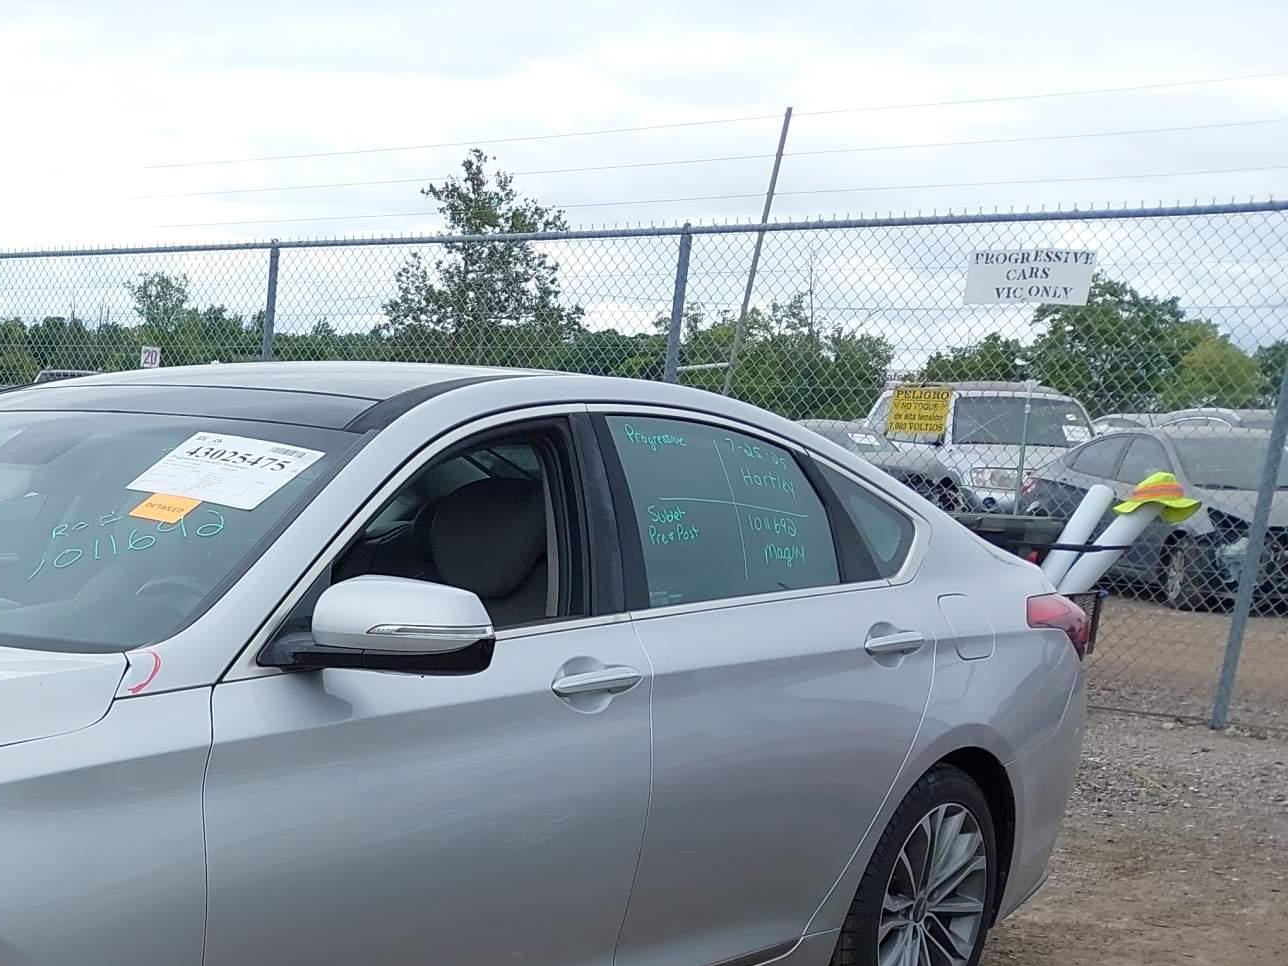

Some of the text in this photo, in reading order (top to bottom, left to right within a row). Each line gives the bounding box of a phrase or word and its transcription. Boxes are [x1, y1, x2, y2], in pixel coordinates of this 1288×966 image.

[974, 250, 1096, 265] PROGRESSIVE
[1005, 266, 1051, 281] CARS
[995, 285, 1074, 299] VIC ONLY
[144, 349, 158, 366] 20
[896, 390, 950, 400] PELIGRO
[186, 446, 292, 471] 43025475
